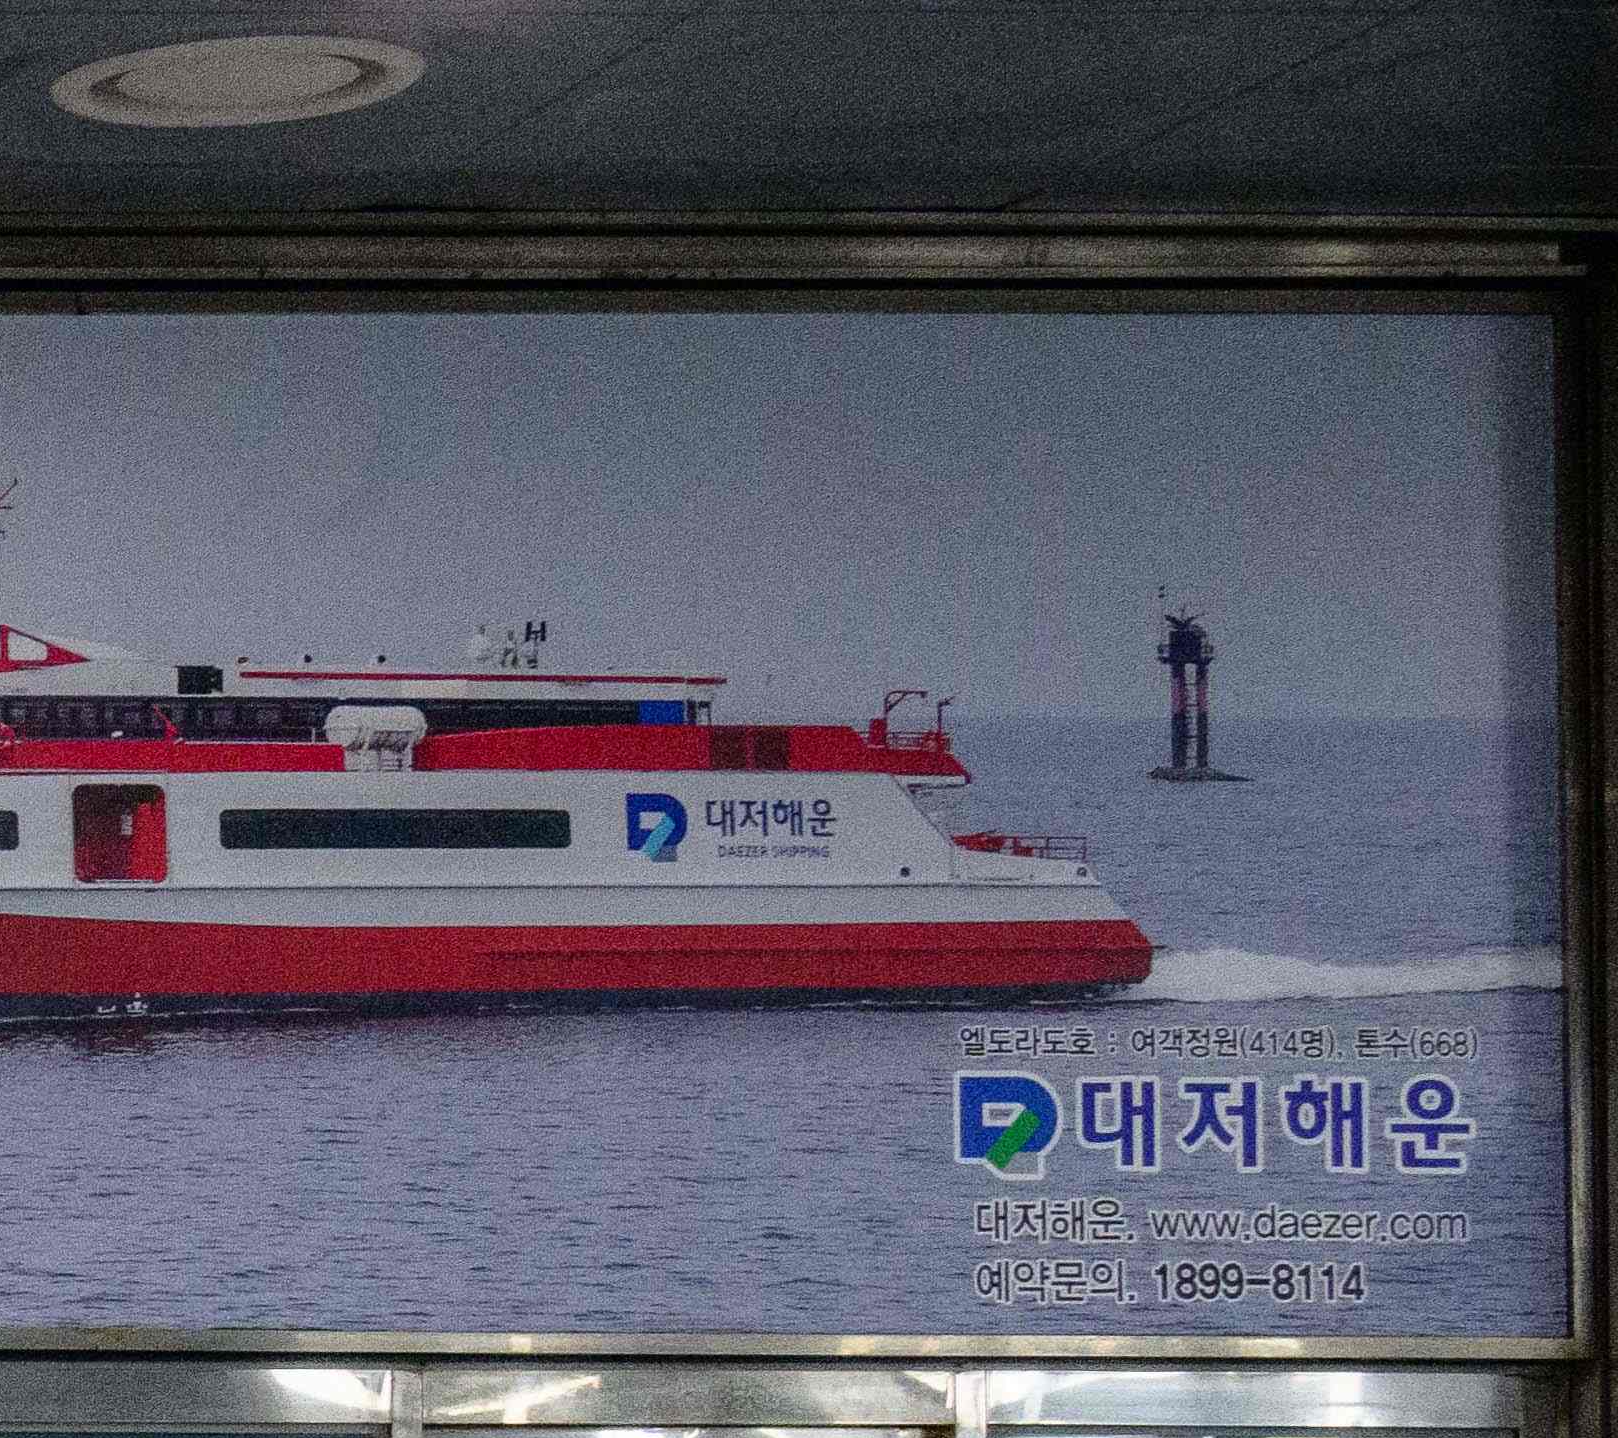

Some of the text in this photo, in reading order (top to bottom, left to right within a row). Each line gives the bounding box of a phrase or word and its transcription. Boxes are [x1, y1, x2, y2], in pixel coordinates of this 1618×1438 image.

[705, 798, 837, 838] 대저해운
[959, 1028, 1095, 1058] 엘도라도호
[1355, 1027, 1479, 1059] 톤수(668)
[1078, 1075, 1474, 1172] 대저해운
[1149, 1206, 1469, 1243] www.daezer.com
[1151, 1261, 1366, 1303] 1899-8114
